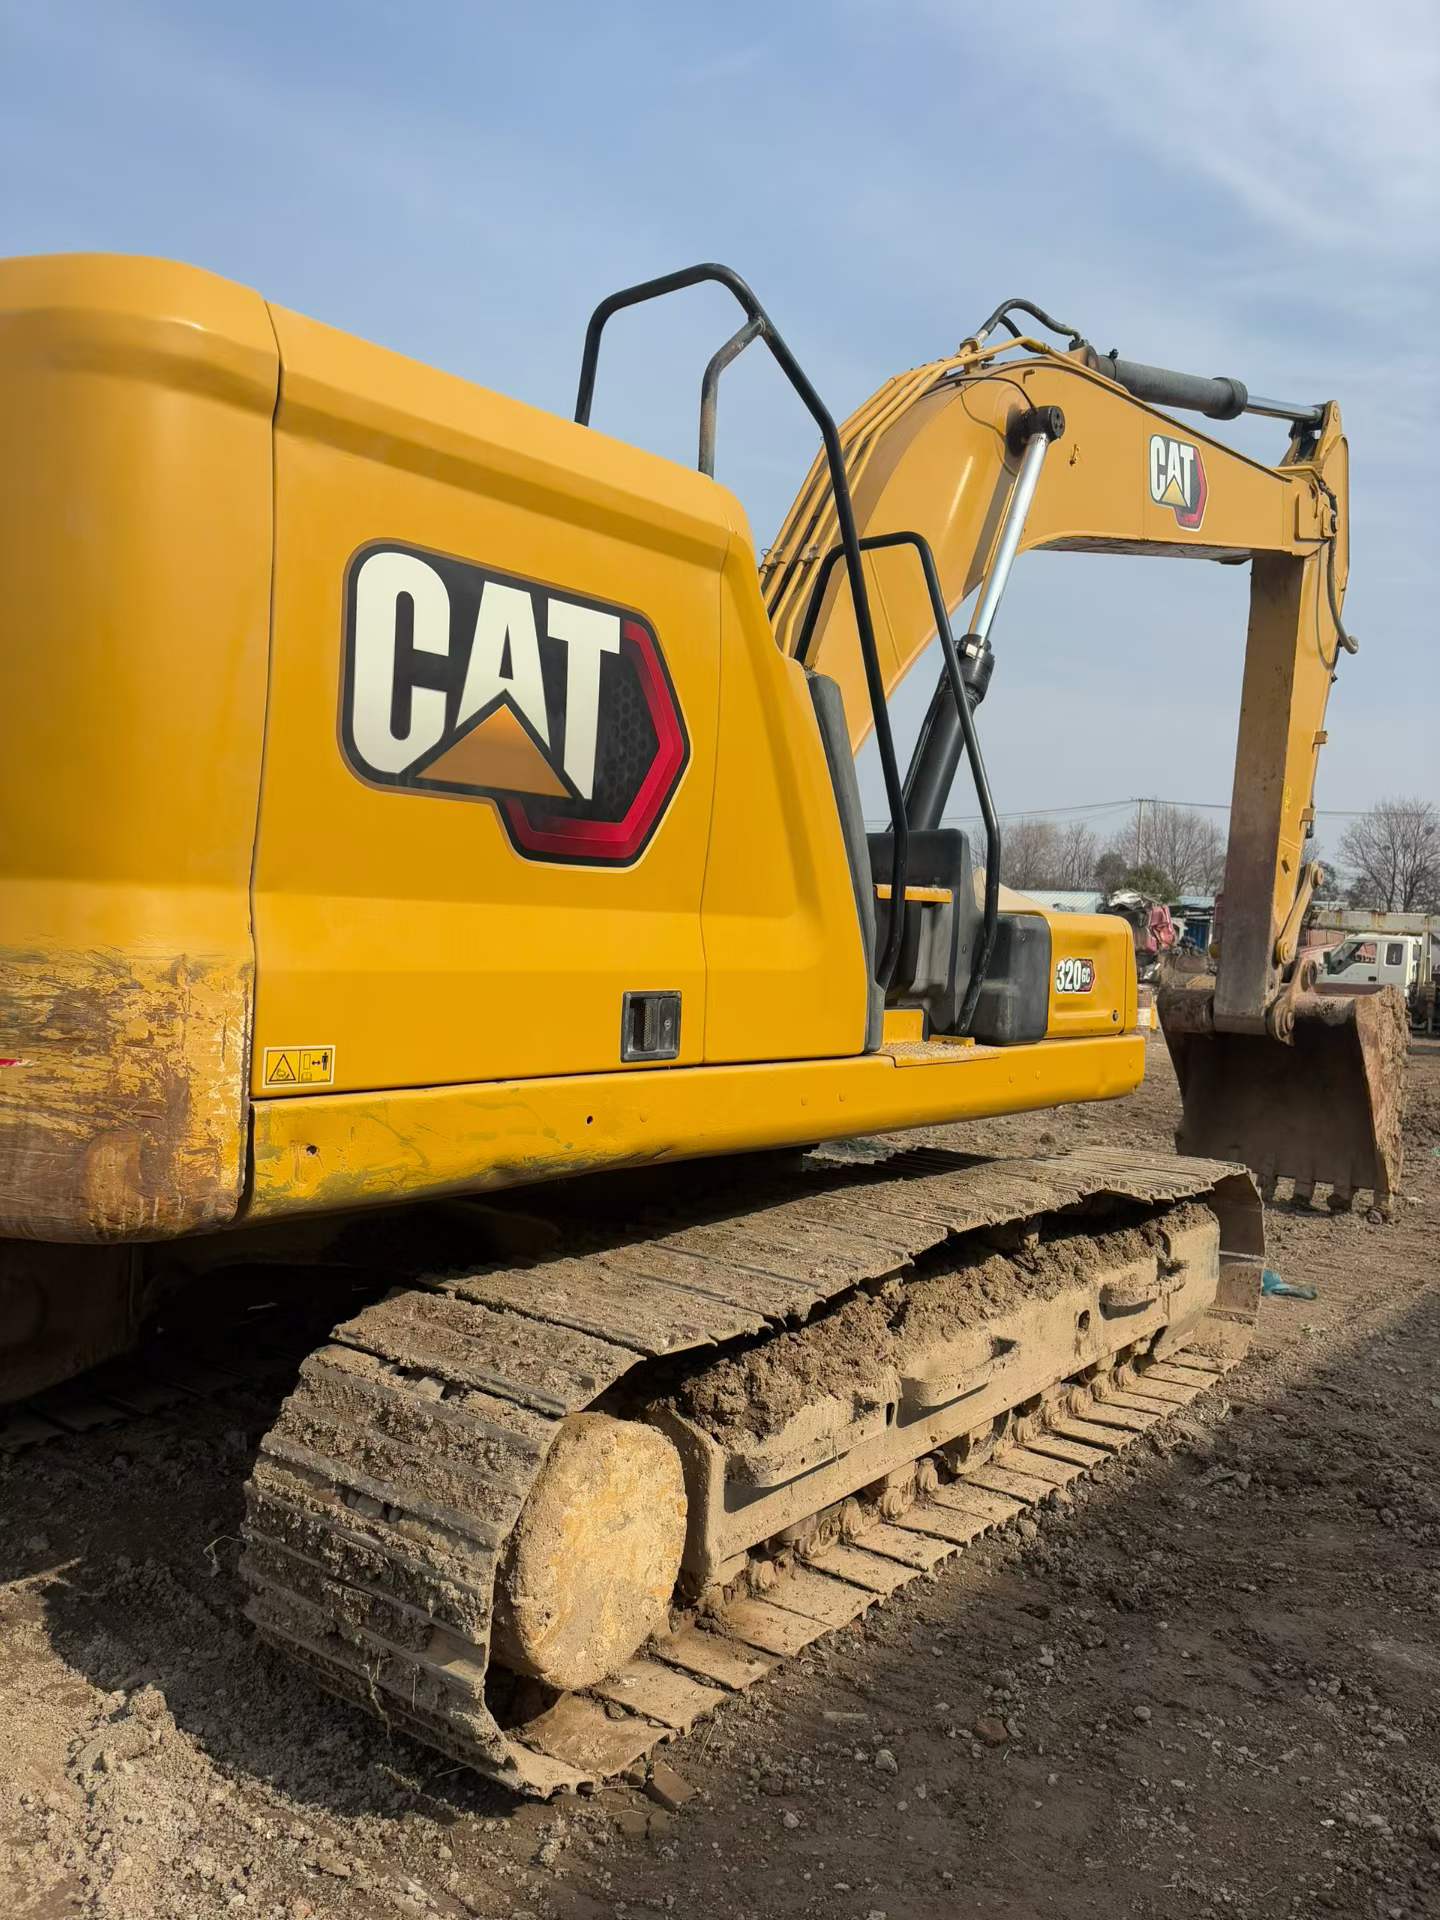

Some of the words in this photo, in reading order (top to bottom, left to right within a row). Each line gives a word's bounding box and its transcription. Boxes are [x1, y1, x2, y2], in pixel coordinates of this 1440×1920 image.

[1150, 435, 1194, 508] CAT
[352, 551, 621, 800] CAT
[1056, 959, 1081, 990] 320
